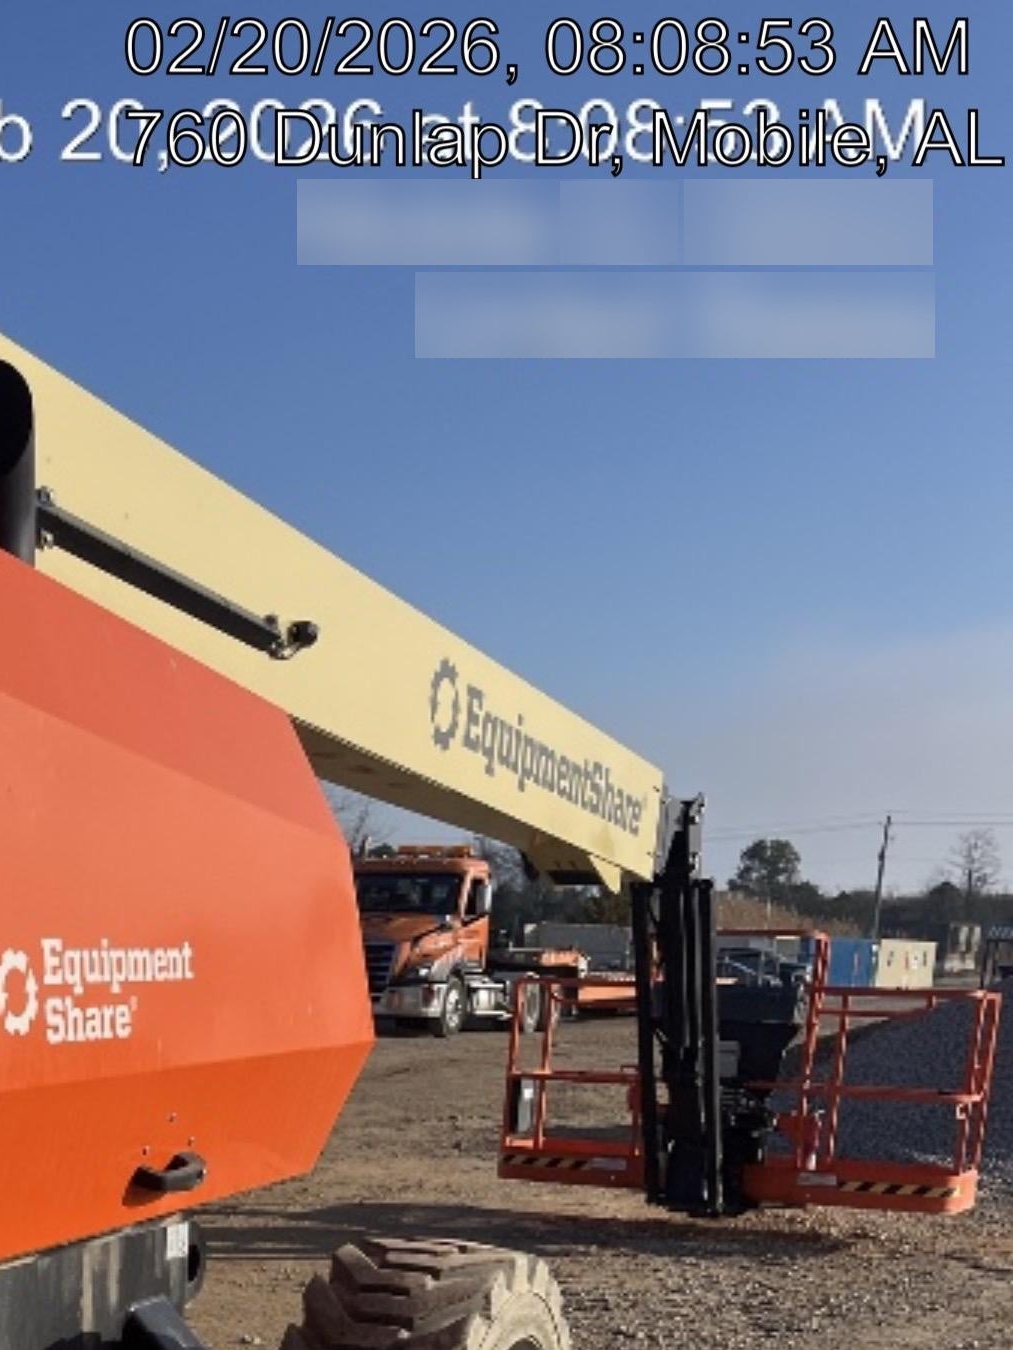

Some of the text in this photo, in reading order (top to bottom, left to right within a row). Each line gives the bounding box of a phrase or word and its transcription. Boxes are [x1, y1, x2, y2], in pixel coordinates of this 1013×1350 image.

[463, 684, 643, 836] EquipmentShare
[41, 938, 194, 994] Equipment
[44, 996, 133, 1044] Share
